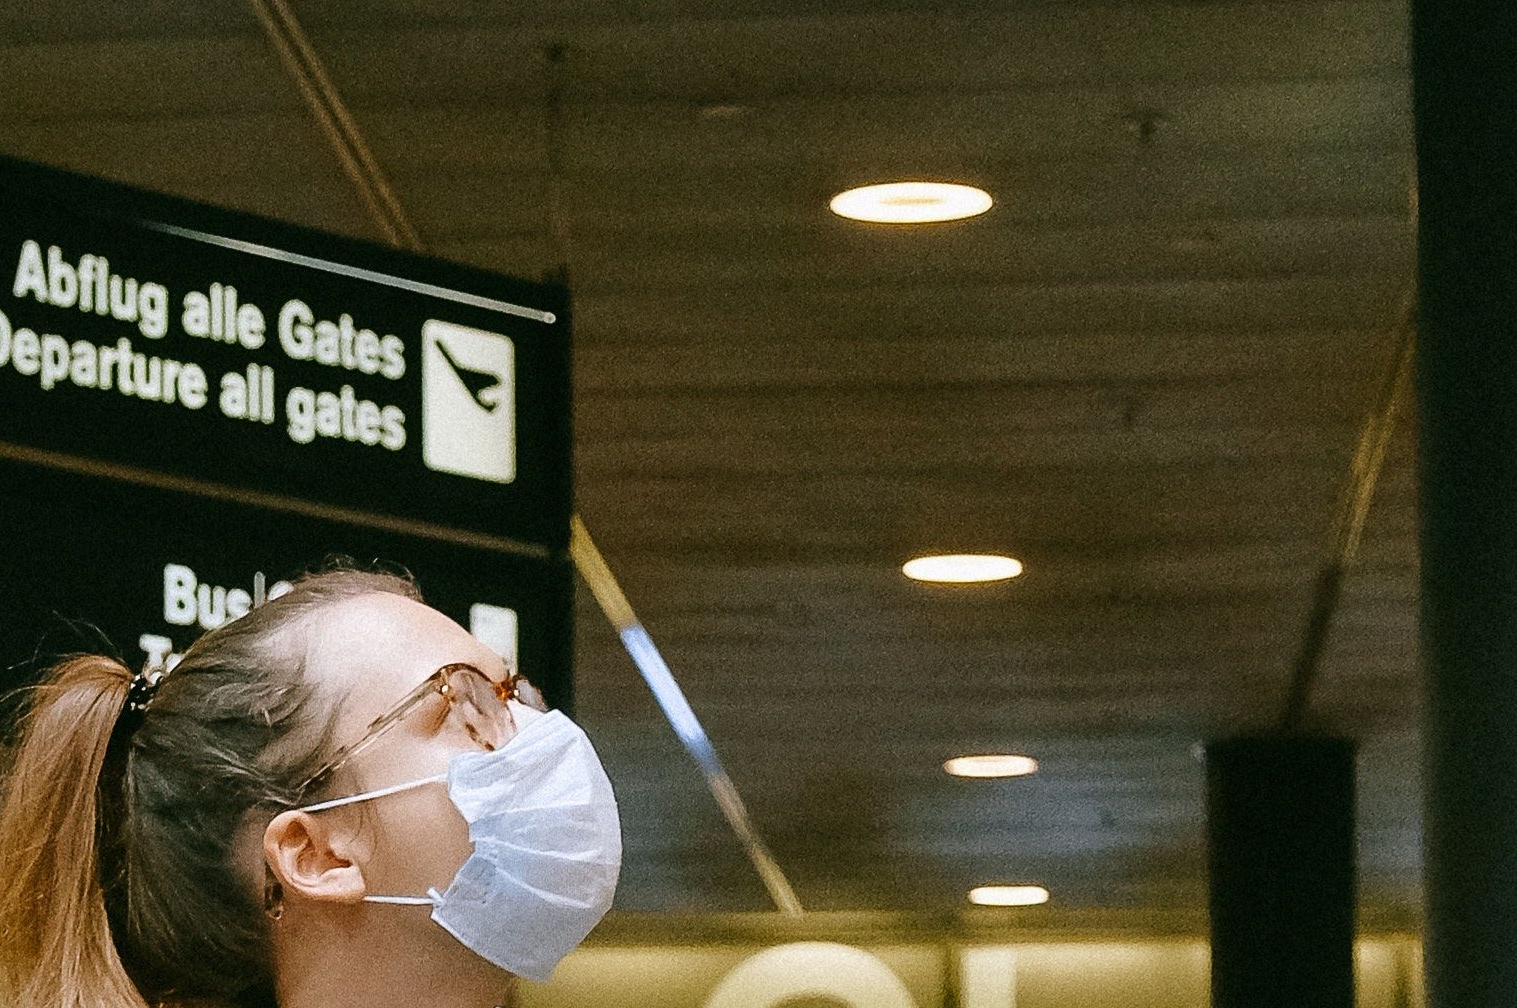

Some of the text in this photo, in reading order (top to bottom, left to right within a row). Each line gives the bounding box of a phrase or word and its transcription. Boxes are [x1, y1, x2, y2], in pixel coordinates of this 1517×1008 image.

[13, 238, 407, 381] Abflug alle Gates
[219, 362, 276, 425] all
[285, 384, 407, 452] gates
